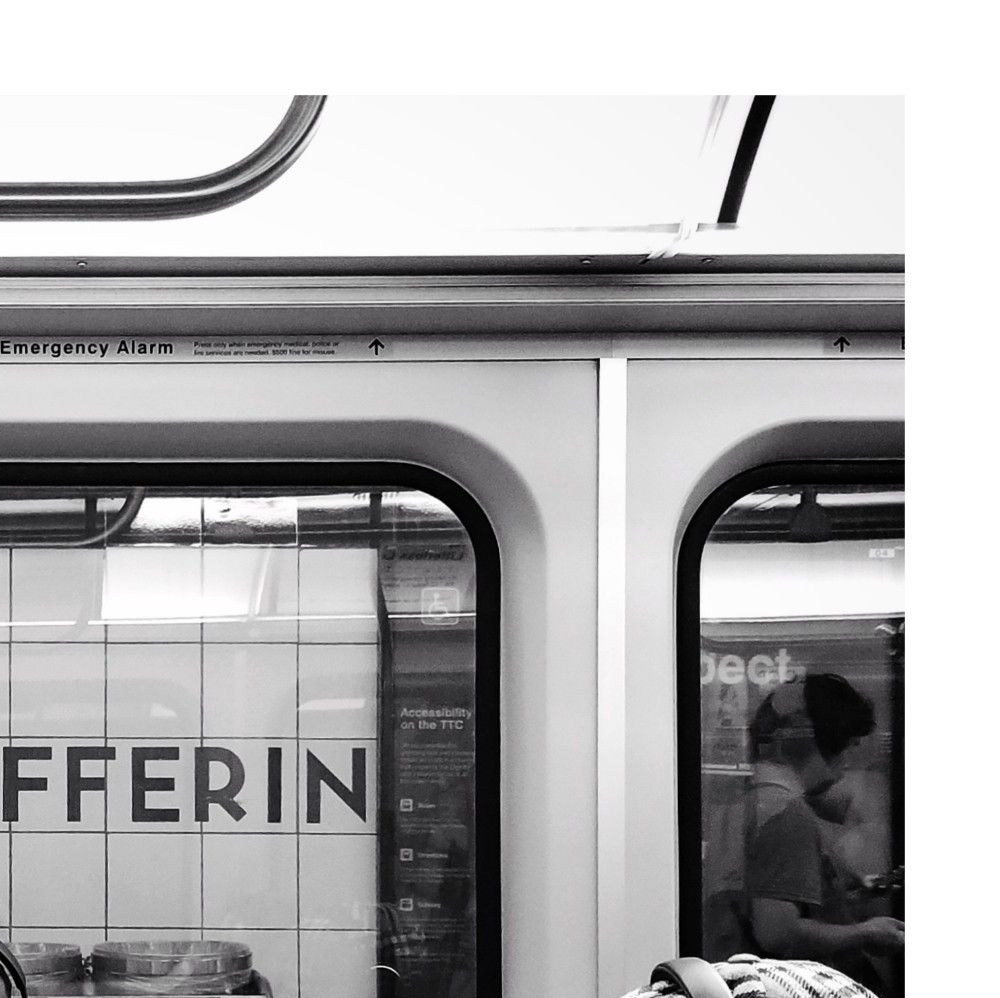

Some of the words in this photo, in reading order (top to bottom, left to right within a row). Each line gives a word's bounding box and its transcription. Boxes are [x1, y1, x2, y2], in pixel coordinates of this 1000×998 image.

[0, 340, 109, 358] Emergency
[117, 340, 174, 355] Alarm
[400, 707, 472, 720] Accessibility
[400, 721, 416, 730] on
[418, 720, 437, 730] the
[440, 720, 464, 730] TTC
